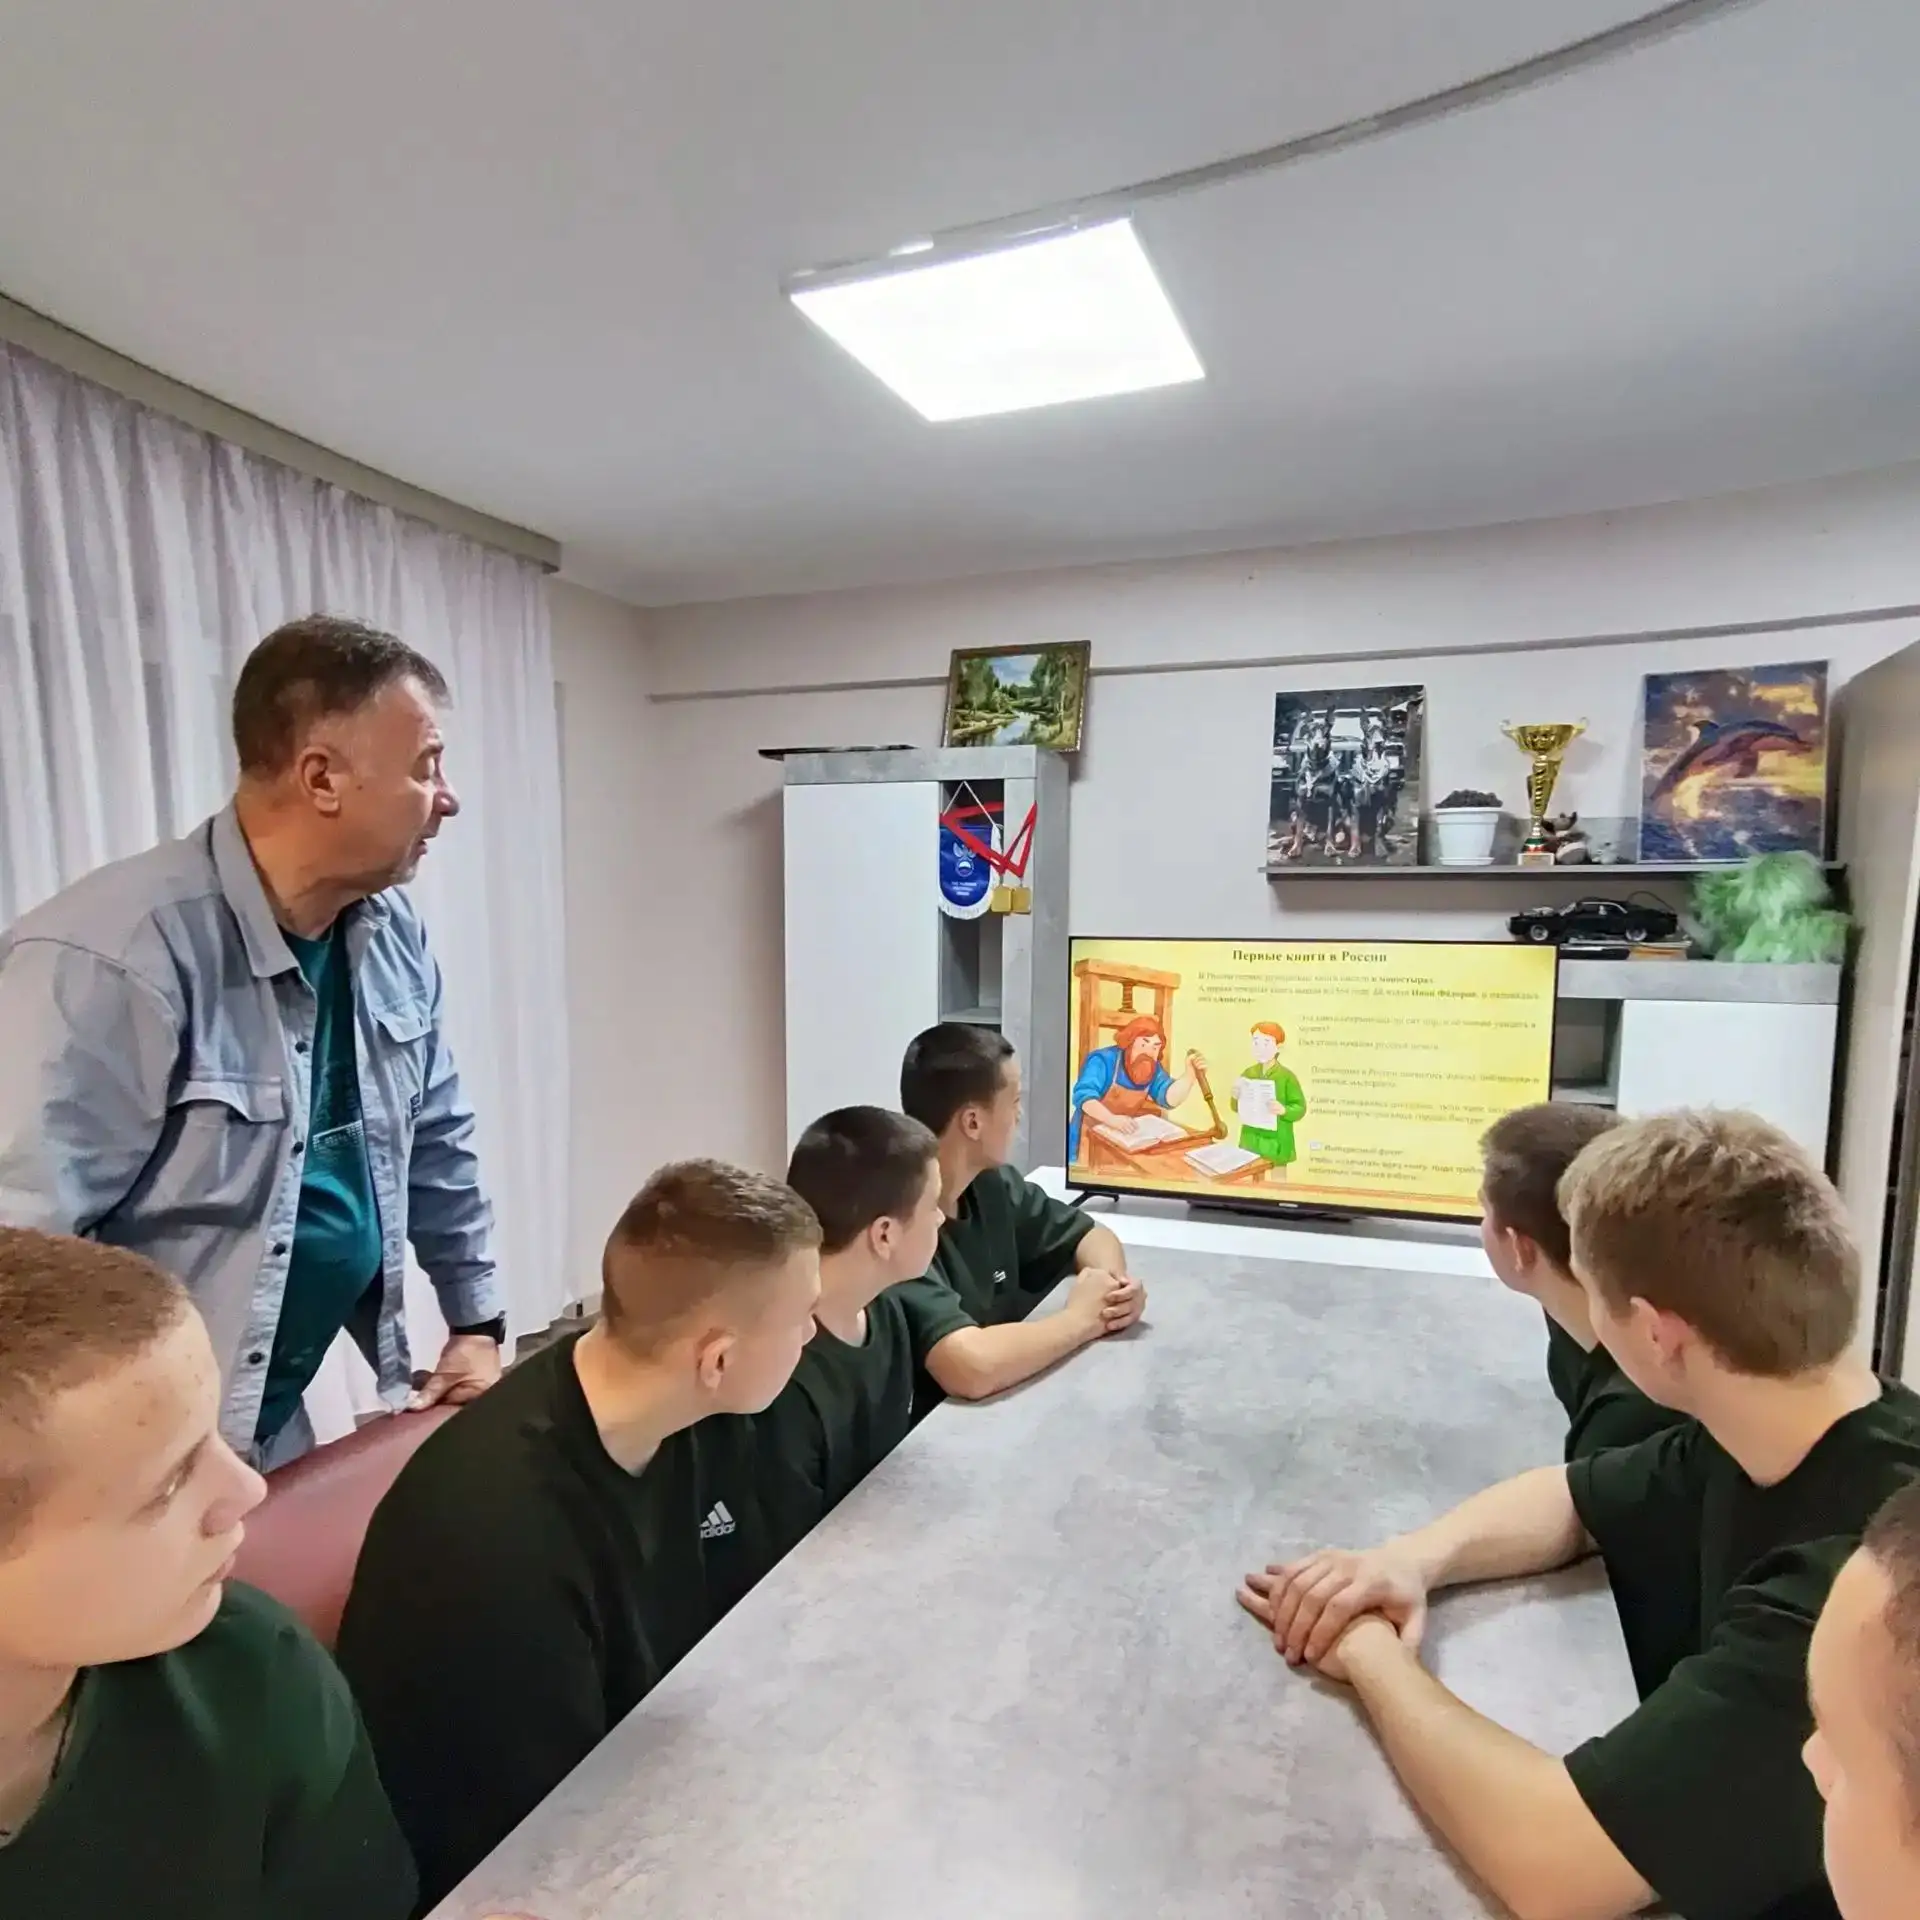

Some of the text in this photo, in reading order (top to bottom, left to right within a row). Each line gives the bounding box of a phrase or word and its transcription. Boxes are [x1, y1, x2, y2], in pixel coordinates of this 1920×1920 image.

[1232, 949, 1388, 963] Первые книги в России
